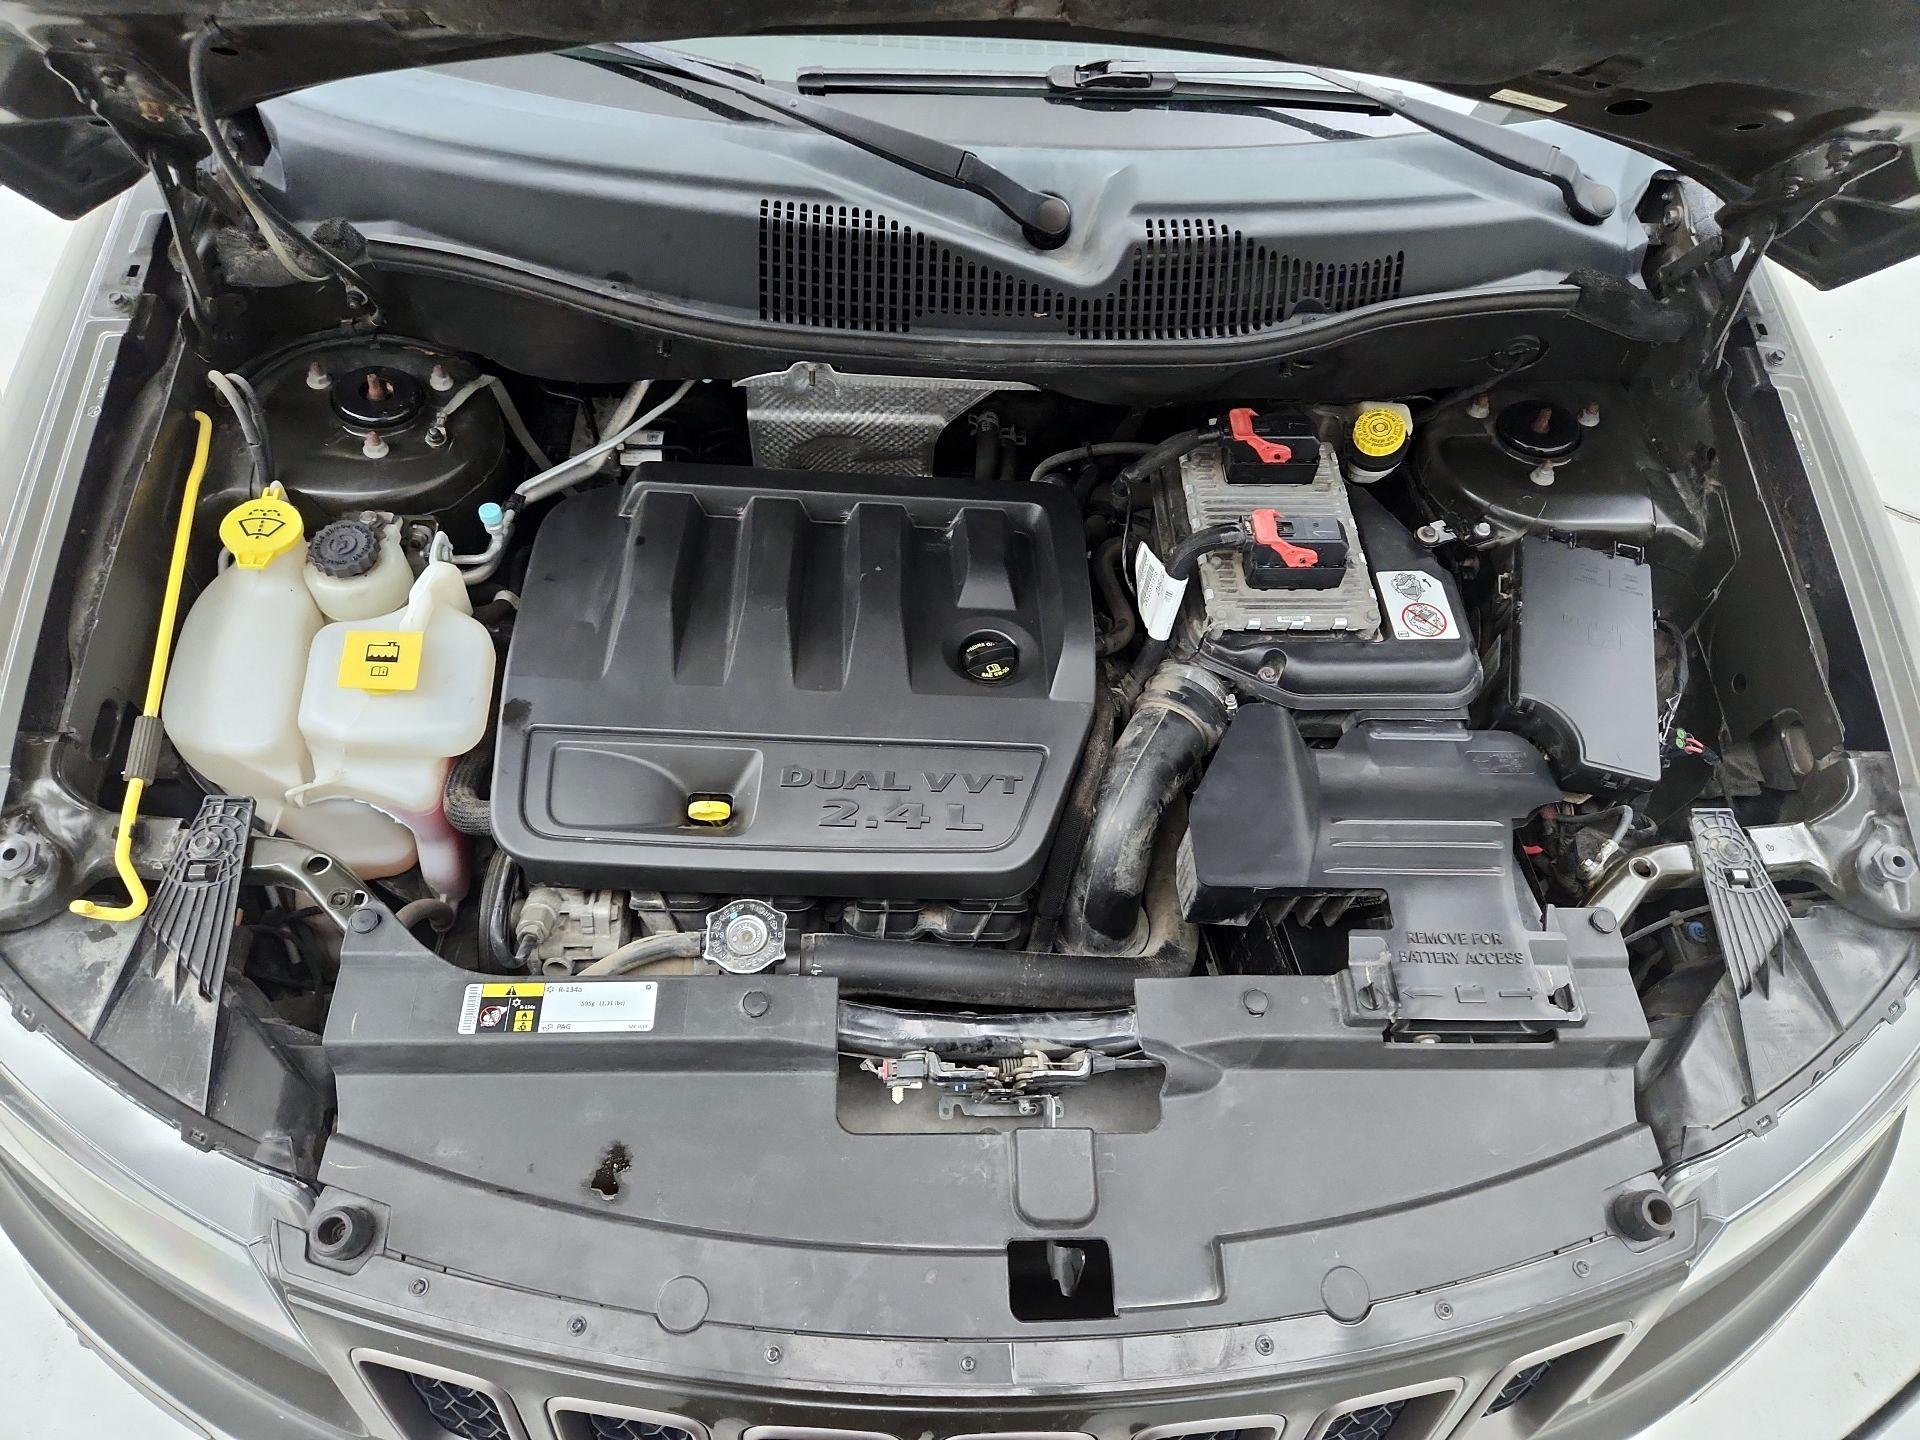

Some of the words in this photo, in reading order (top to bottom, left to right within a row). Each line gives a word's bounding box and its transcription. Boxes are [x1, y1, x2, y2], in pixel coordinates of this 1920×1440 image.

[780, 768, 911, 791] DUAL
[922, 773, 1023, 794] VVT
[1406, 931, 1468, 945] REMOVE
[1472, 932, 1503, 945] FOR
[1399, 951, 1460, 964] BATTERY
[1465, 951, 1525, 965] ACCESS
